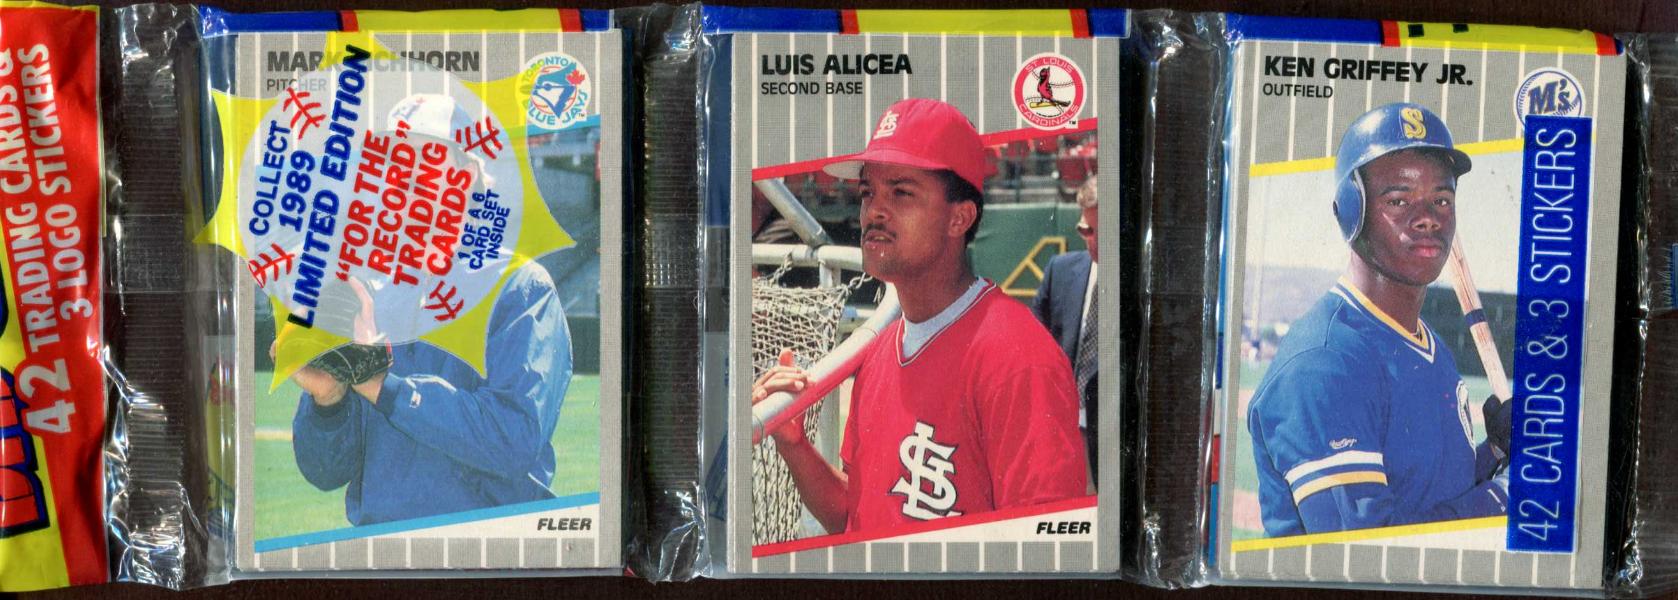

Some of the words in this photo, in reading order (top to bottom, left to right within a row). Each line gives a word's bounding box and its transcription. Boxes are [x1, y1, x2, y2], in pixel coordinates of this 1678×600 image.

[521, 56, 569, 82] TORONTO
[762, 54, 814, 75] LUIS
[823, 54, 913, 75] ALICEA
[1026, 61, 1039, 72] ST
[1043, 57, 1074, 73] LOUIS
[1264, 55, 1315, 77] KEN
[1324, 58, 1429, 83] GRIFFEY
[1436, 64, 1473, 86] JR.
[267, 78, 327, 92] PITCHER
[761, 82, 820, 95] SECOND
[826, 82, 863, 95] BASE
[1263, 83, 1333, 98] OUTFIELD
[17, 43, 71, 195] STICKERS
[522, 99, 556, 125] BLUE
[562, 89, 588, 123] JAYS
[1019, 104, 1079, 127] CARDINALS
[1401, 108, 1427, 139] S
[0, 85, 33, 194] CARDS
[249, 120, 291, 236] COLLECT
[354, 130, 390, 194] THE
[279, 150, 316, 232] 1989
[287, 190, 340, 328] LIMITED
[320, 44, 371, 181] EDITION
[367, 120, 416, 275] RECORD”
[393, 143, 448, 285] TRADING
[427, 167, 472, 276] CARDS
[468, 208, 482, 219] A
[1531, 128, 1577, 284] STICKERS
[45, 204, 88, 288] LOGO
[336, 200, 375, 281] “FOR
[461, 222, 476, 246] OF
[469, 226, 490, 270] CARD
[481, 189, 499, 220] SET
[486, 207, 510, 259] INSIDE
[457, 251, 471, 259] 1
[6, 202, 61, 352] TRADING
[60, 298, 93, 321] 3
[1529, 300, 1569, 318] 3
[1527, 333, 1568, 359] &
[19, 359, 76, 434] 42
[1521, 373, 1566, 485] CARDS
[537, 517, 592, 531] FLEER
[1036, 521, 1091, 535] FLEER
[1518, 499, 1560, 541] 42
